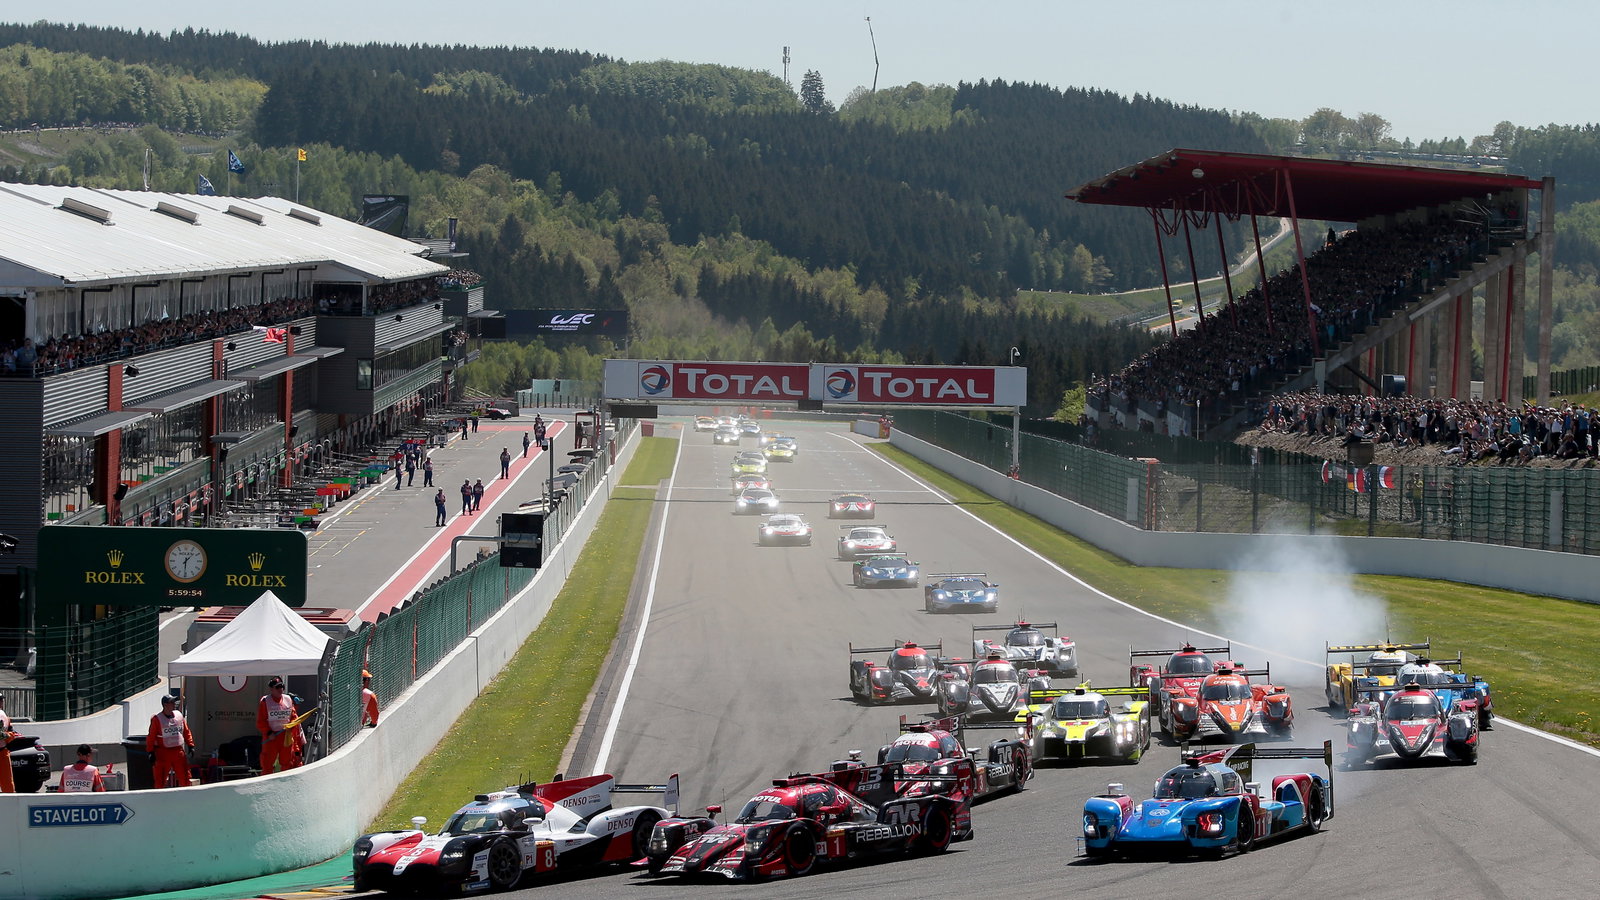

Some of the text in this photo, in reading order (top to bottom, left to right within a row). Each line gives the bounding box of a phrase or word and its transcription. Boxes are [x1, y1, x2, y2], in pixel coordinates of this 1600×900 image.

[550, 313, 595, 325] WEC
[678, 367, 804, 397] TOTAL
[864, 371, 989, 399] TOTAL
[85, 571, 145, 585] ROLEX
[226, 574, 287, 588] ROLEX
[168, 589, 203, 597] 5:59:54
[65, 780, 91, 788] COURSE
[562, 796, 588, 808] DENSO
[749, 795, 782, 804] MOTUL
[33, 807, 122, 823] STAVELOT 7
[887, 803, 921, 826] TVR
[607, 817, 635, 832] DENSO
[856, 823, 922, 843] REBELLION
[833, 836, 840, 856] 1
[526, 854, 533, 864] P1
[544, 849, 553, 868] 8
